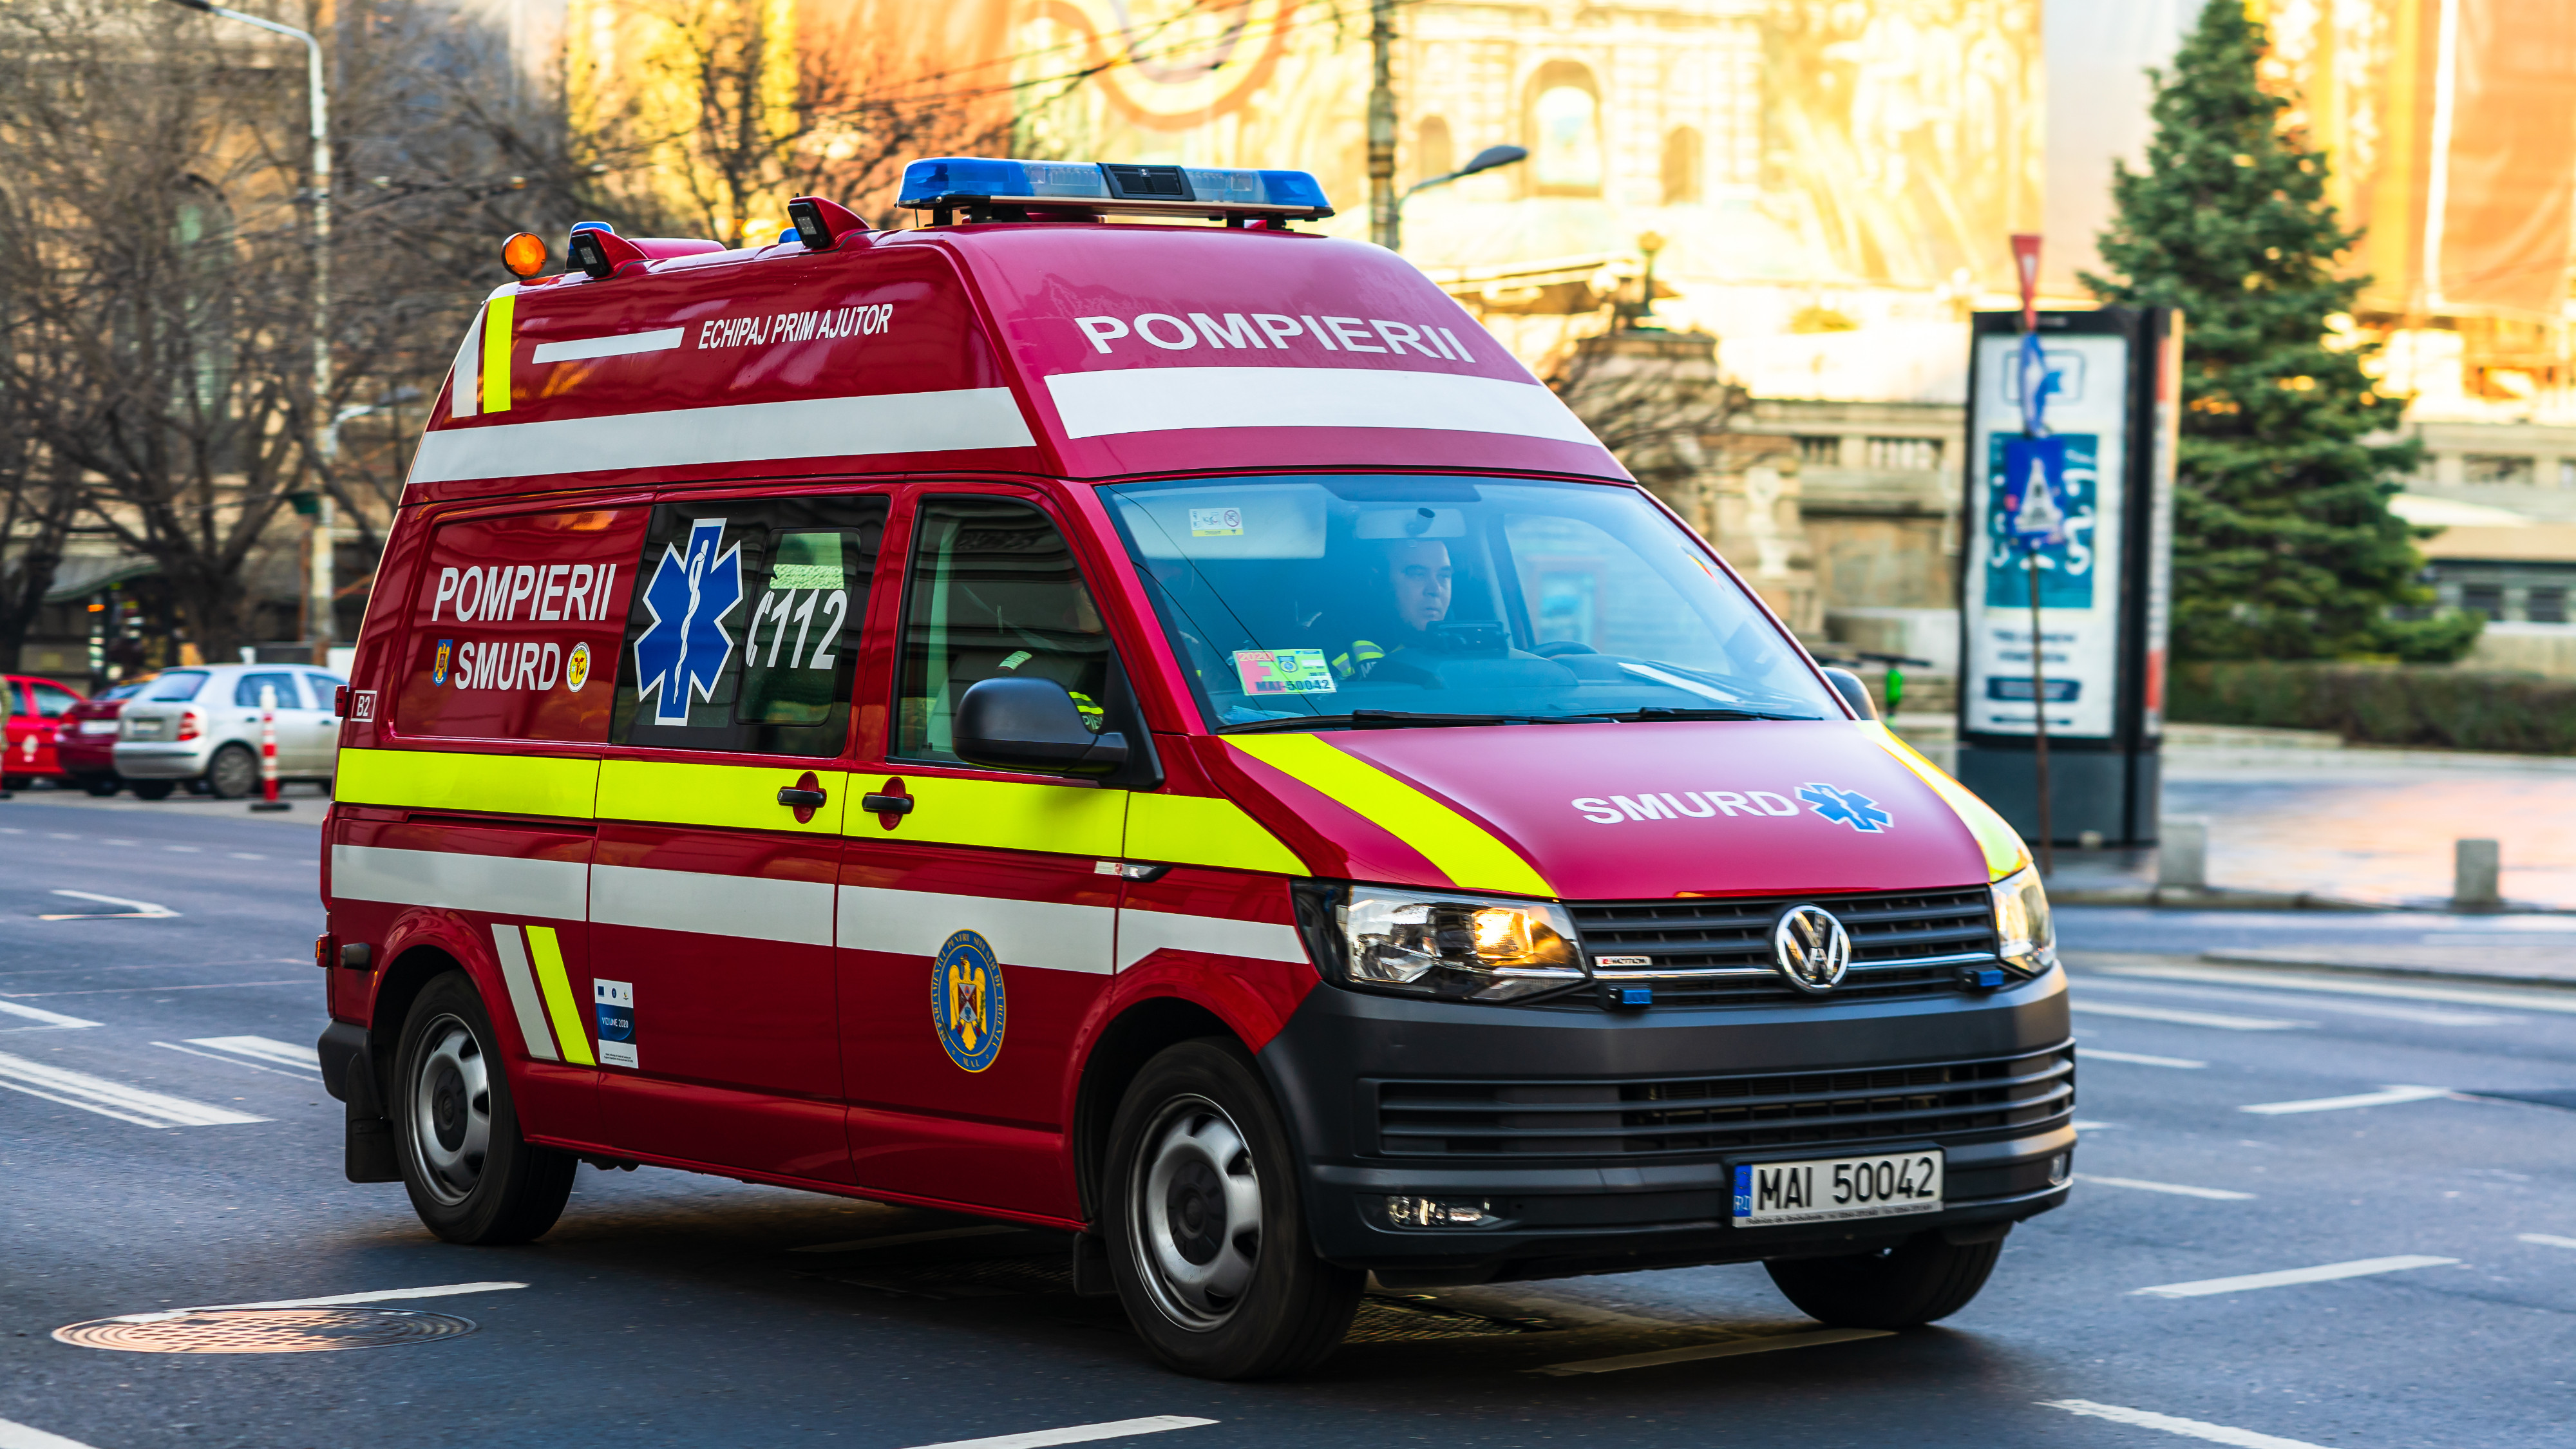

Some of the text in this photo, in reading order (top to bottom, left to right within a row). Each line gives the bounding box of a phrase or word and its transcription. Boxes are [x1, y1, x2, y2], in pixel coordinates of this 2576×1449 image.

[698, 303, 893, 350] ECHIPAJ PRIM AJUTOR
[1074, 313, 1476, 363] POMPIERII
[432, 564, 616, 621] POMPIERII
[764, 589, 848, 670] 112
[455, 641, 560, 690] SMURD
[1238, 652, 1273, 661] 2020
[356, 696, 370, 717] B2
[1571, 791, 1800, 824] SMURD
[601, 1017, 629, 1028] VIZIUNE 2020
[1757, 1157, 1935, 1211] MAI 50042
